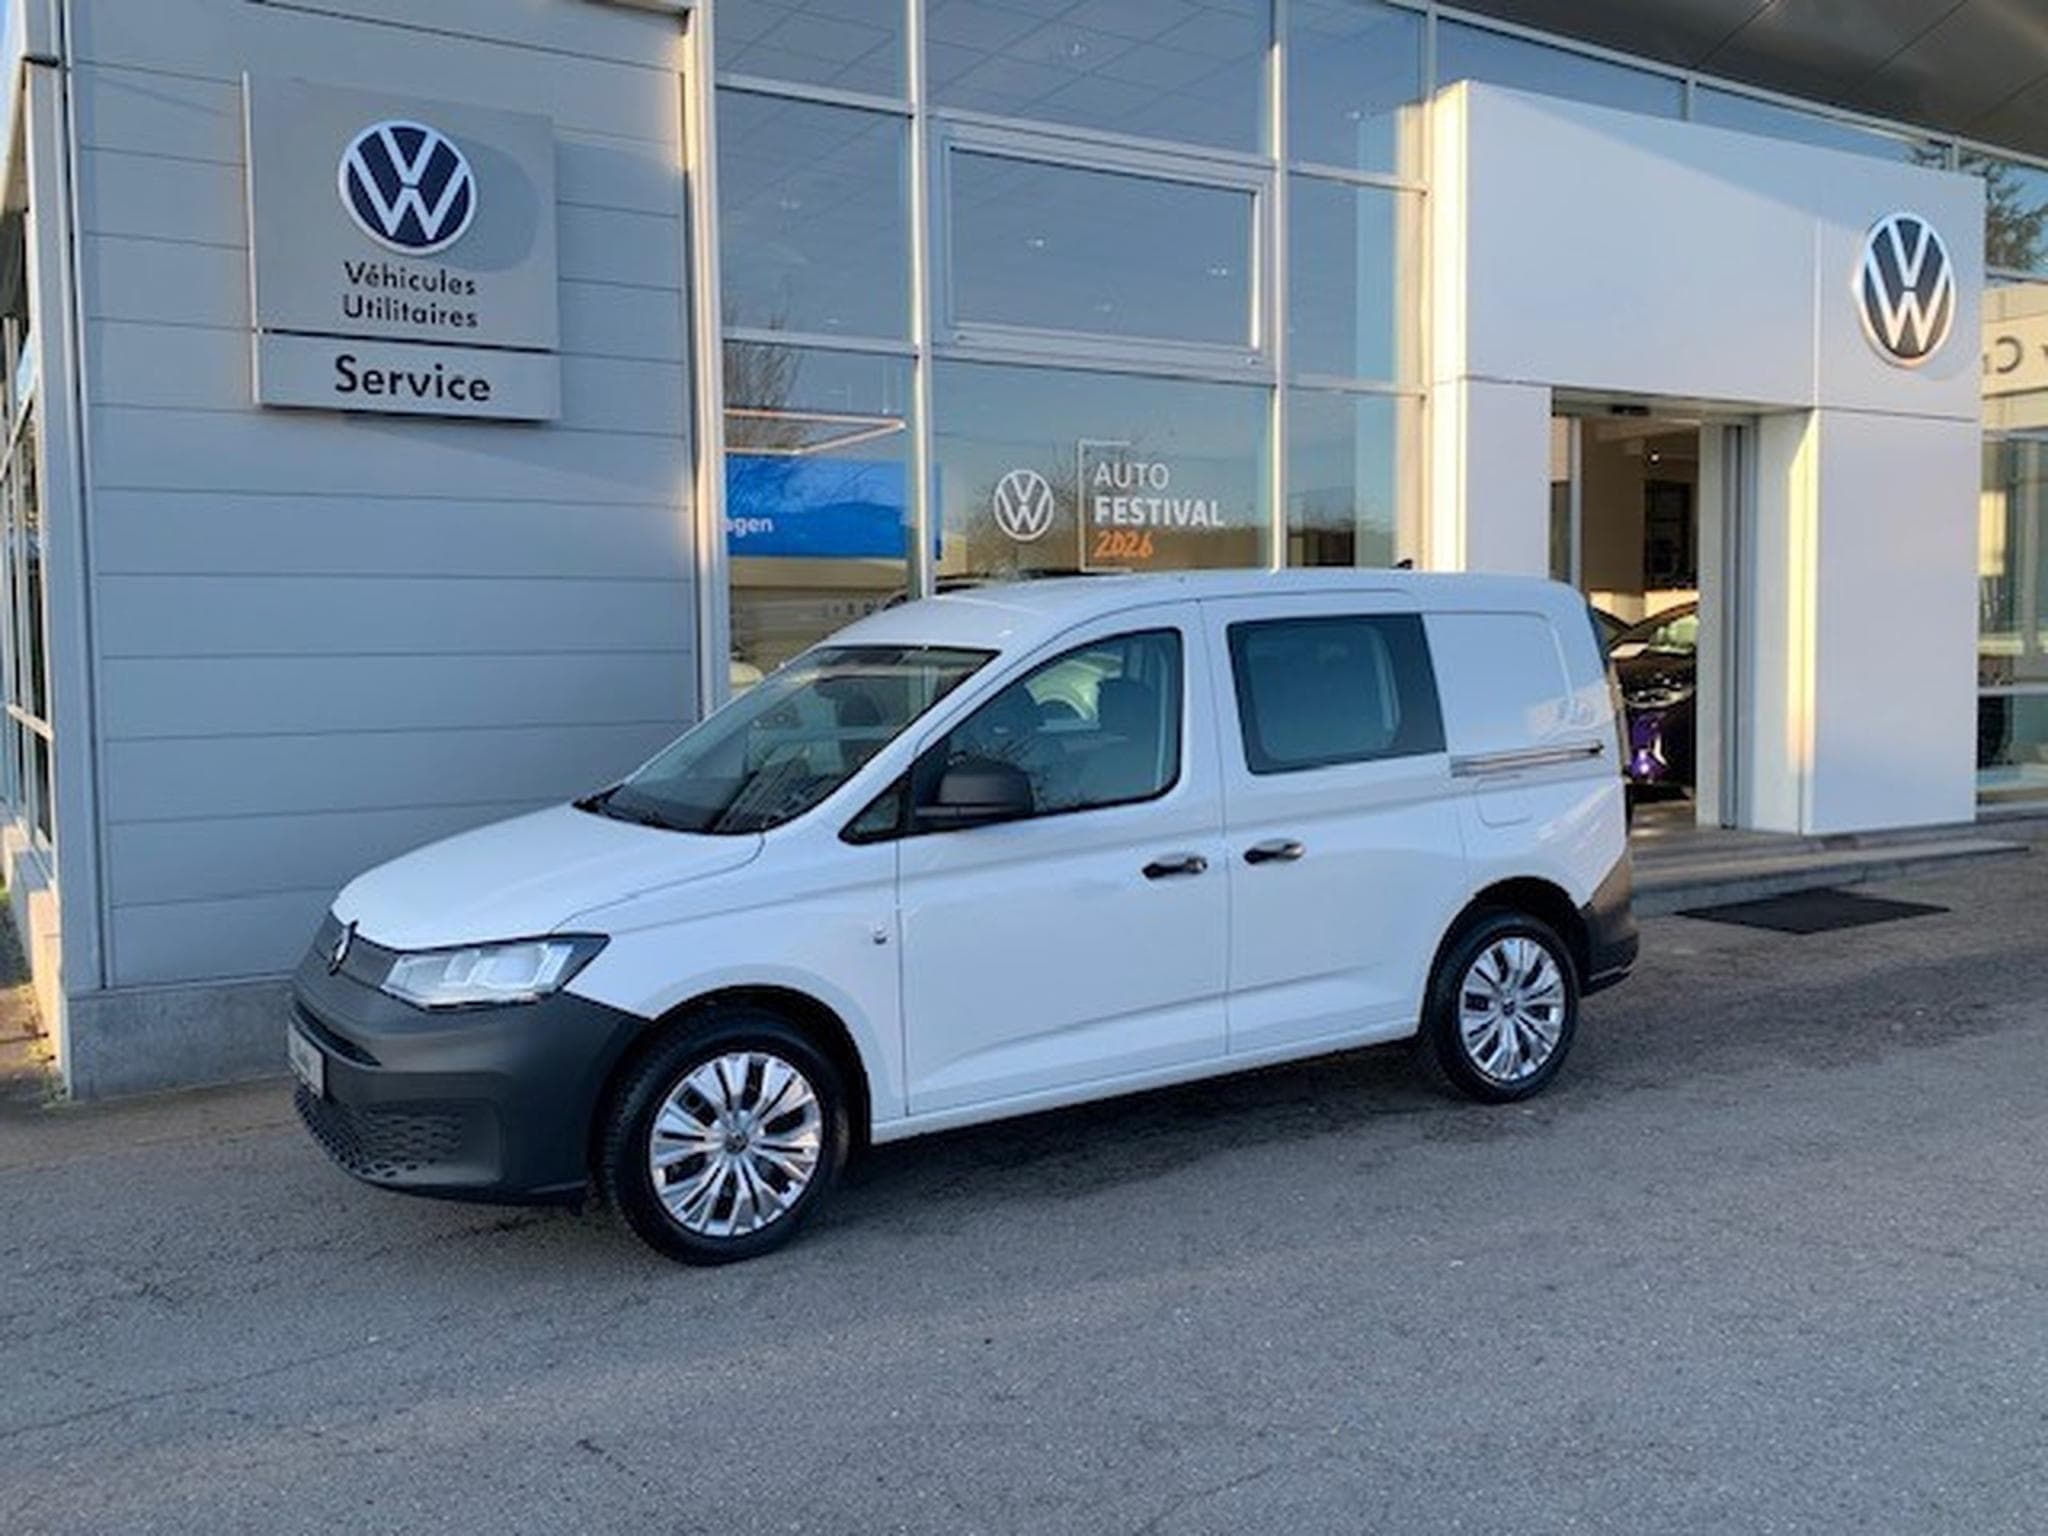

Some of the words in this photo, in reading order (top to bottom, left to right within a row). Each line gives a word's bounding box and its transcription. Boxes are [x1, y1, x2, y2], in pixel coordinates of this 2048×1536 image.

[340, 121, 475, 253] VW
[344, 261, 477, 295] Véhicules
[1859, 214, 1955, 362] VW
[343, 294, 479, 327] Utilitaires
[335, 353, 491, 402] Service
[1093, 462, 1170, 490] AUTO
[994, 470, 1054, 541] VW
[1094, 496, 1226, 527] FESTIVAL
[1093, 530, 1154, 559] 2026
